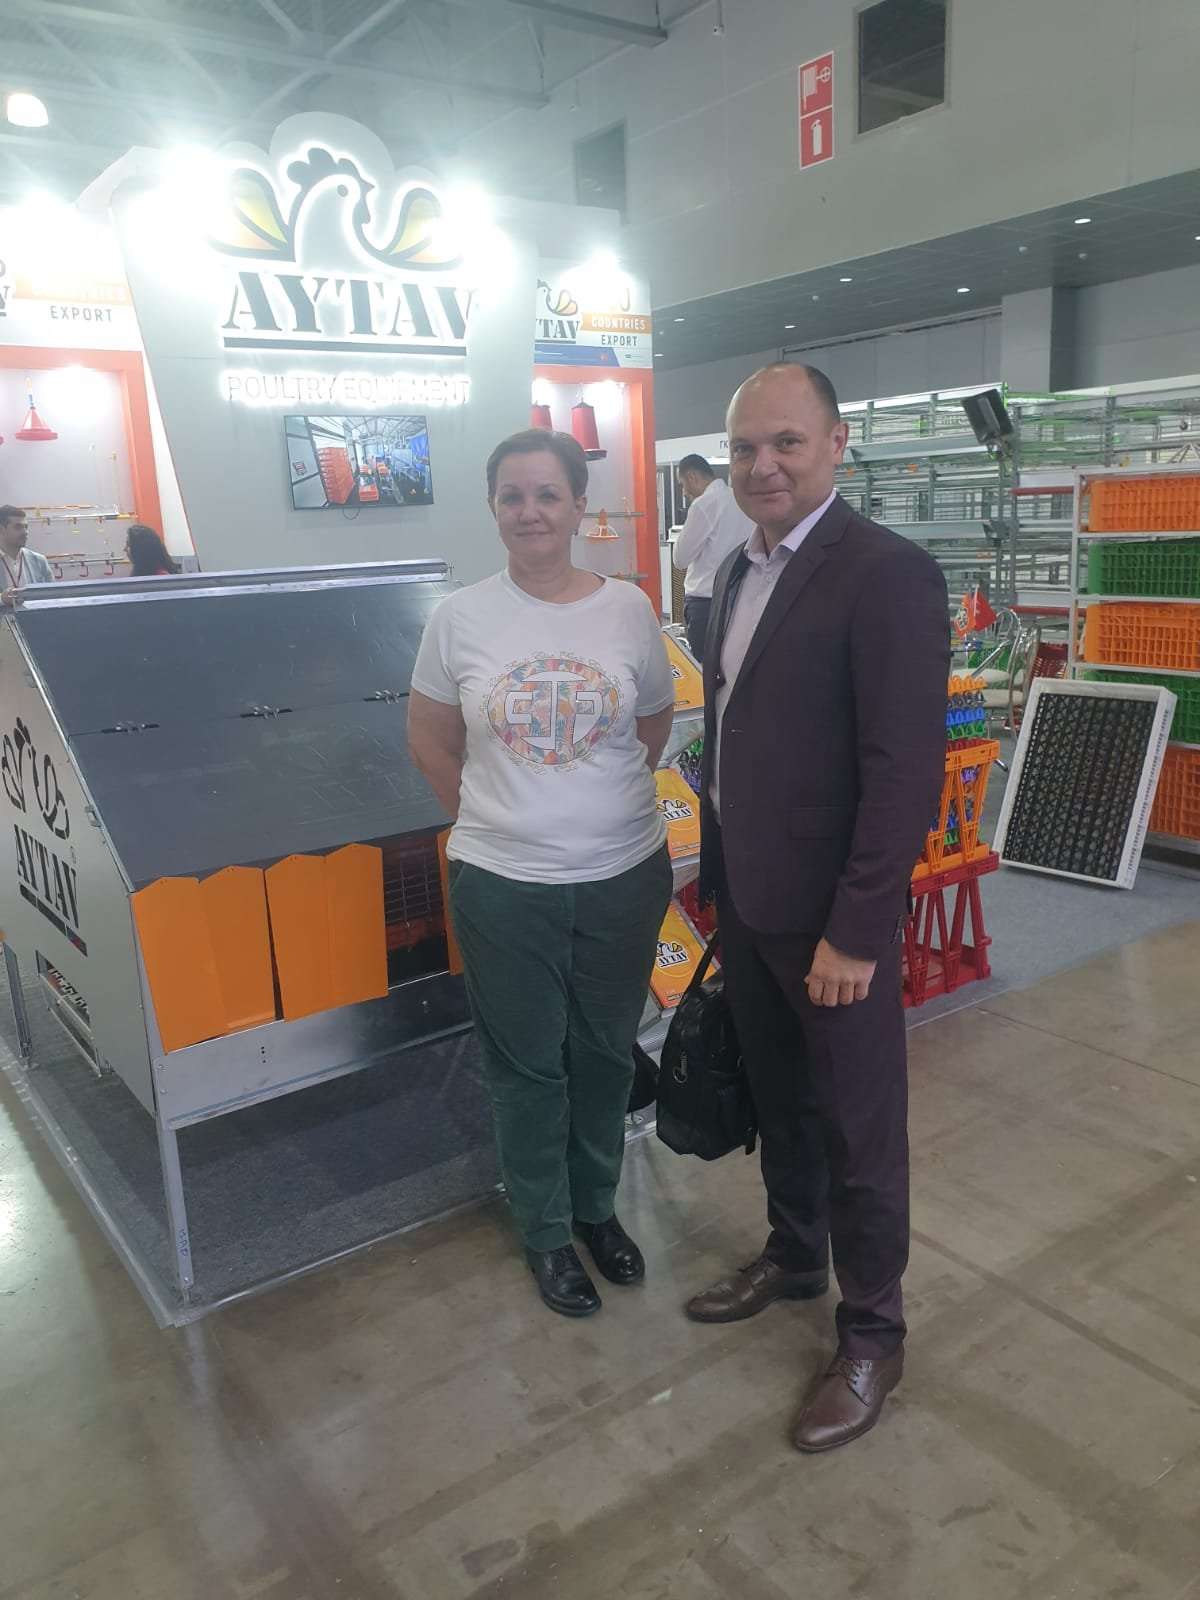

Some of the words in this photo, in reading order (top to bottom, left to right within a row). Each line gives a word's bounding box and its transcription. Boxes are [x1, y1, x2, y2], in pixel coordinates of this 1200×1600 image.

[49, 304, 113, 323] EXPORT
[221, 271, 475, 340] AYTAV
[535, 318, 580, 339] TAV
[601, 334, 638, 347] EXPORT
[227, 375, 337, 402] POULTRY
[342, 377, 471, 405] EQUIPMENT
[14, 823, 79, 929] AYTAV
